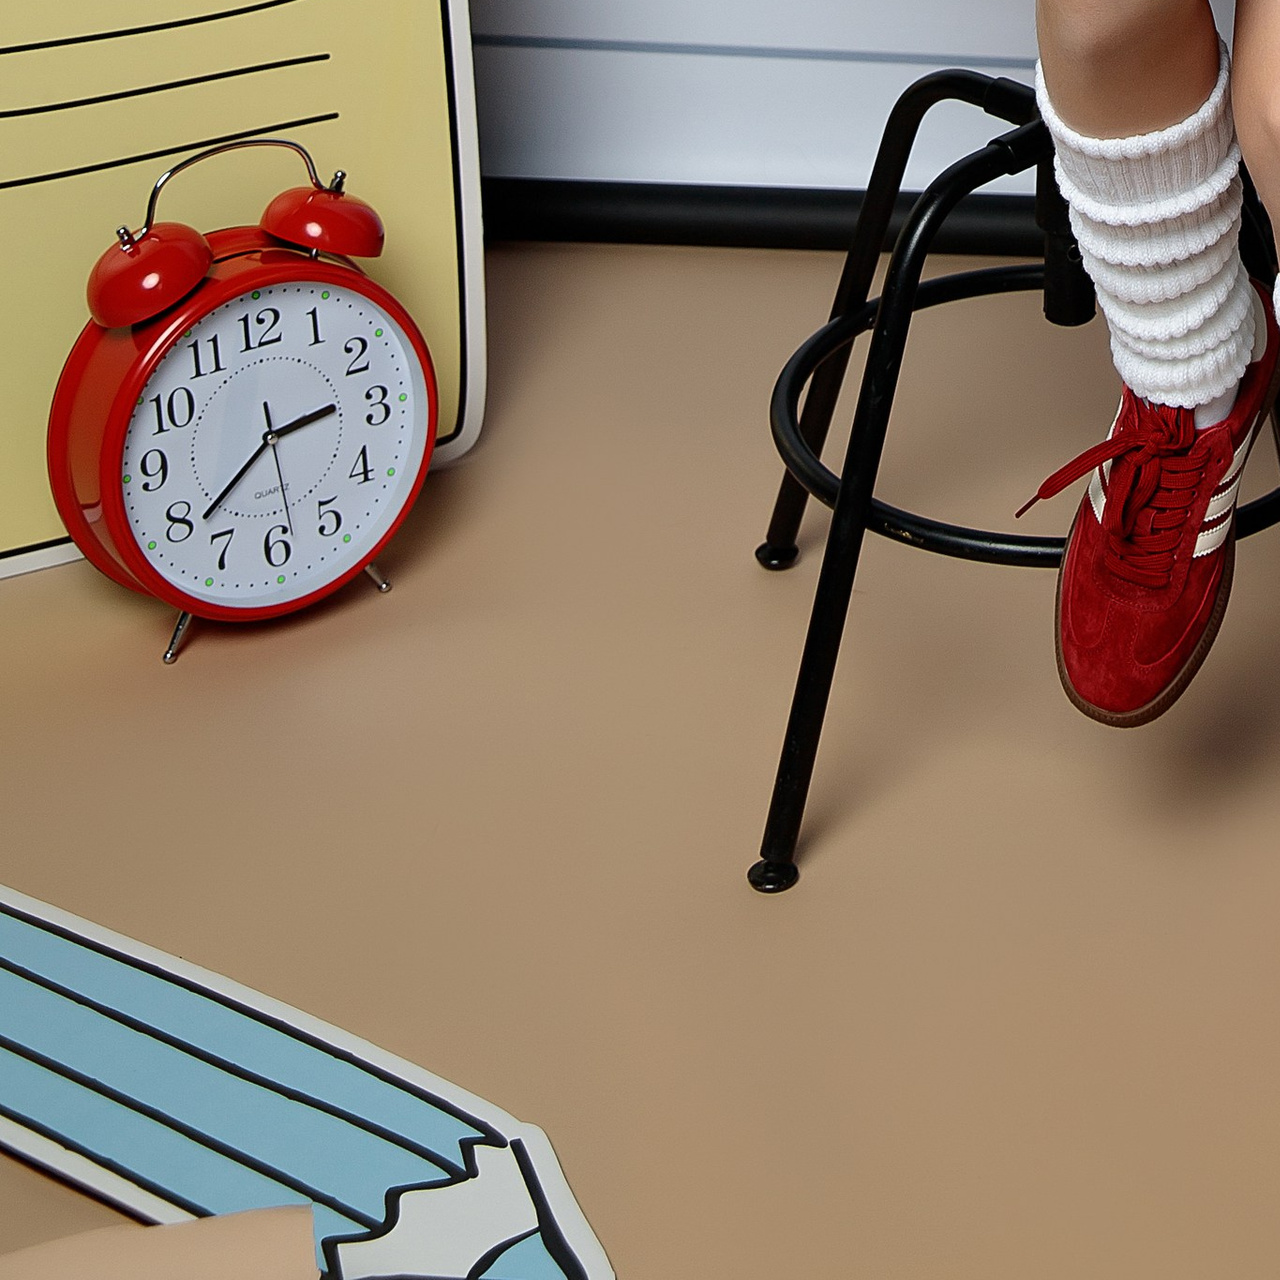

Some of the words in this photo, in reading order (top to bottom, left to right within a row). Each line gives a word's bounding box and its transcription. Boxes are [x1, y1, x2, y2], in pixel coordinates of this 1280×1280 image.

[237, 306, 283, 354] 12
[305, 306, 326, 347] 1
[186, 333, 227, 380] 11
[343, 336, 370, 377] 2
[148, 386, 195, 436] 10
[364, 384, 391, 426] 3
[140, 448, 169, 492] 9
[348, 444, 375, 485] 4
[165, 500, 194, 543] 8
[317, 495, 342, 537] 5
[210, 528, 235, 571] 7
[263, 524, 291, 568] 6
